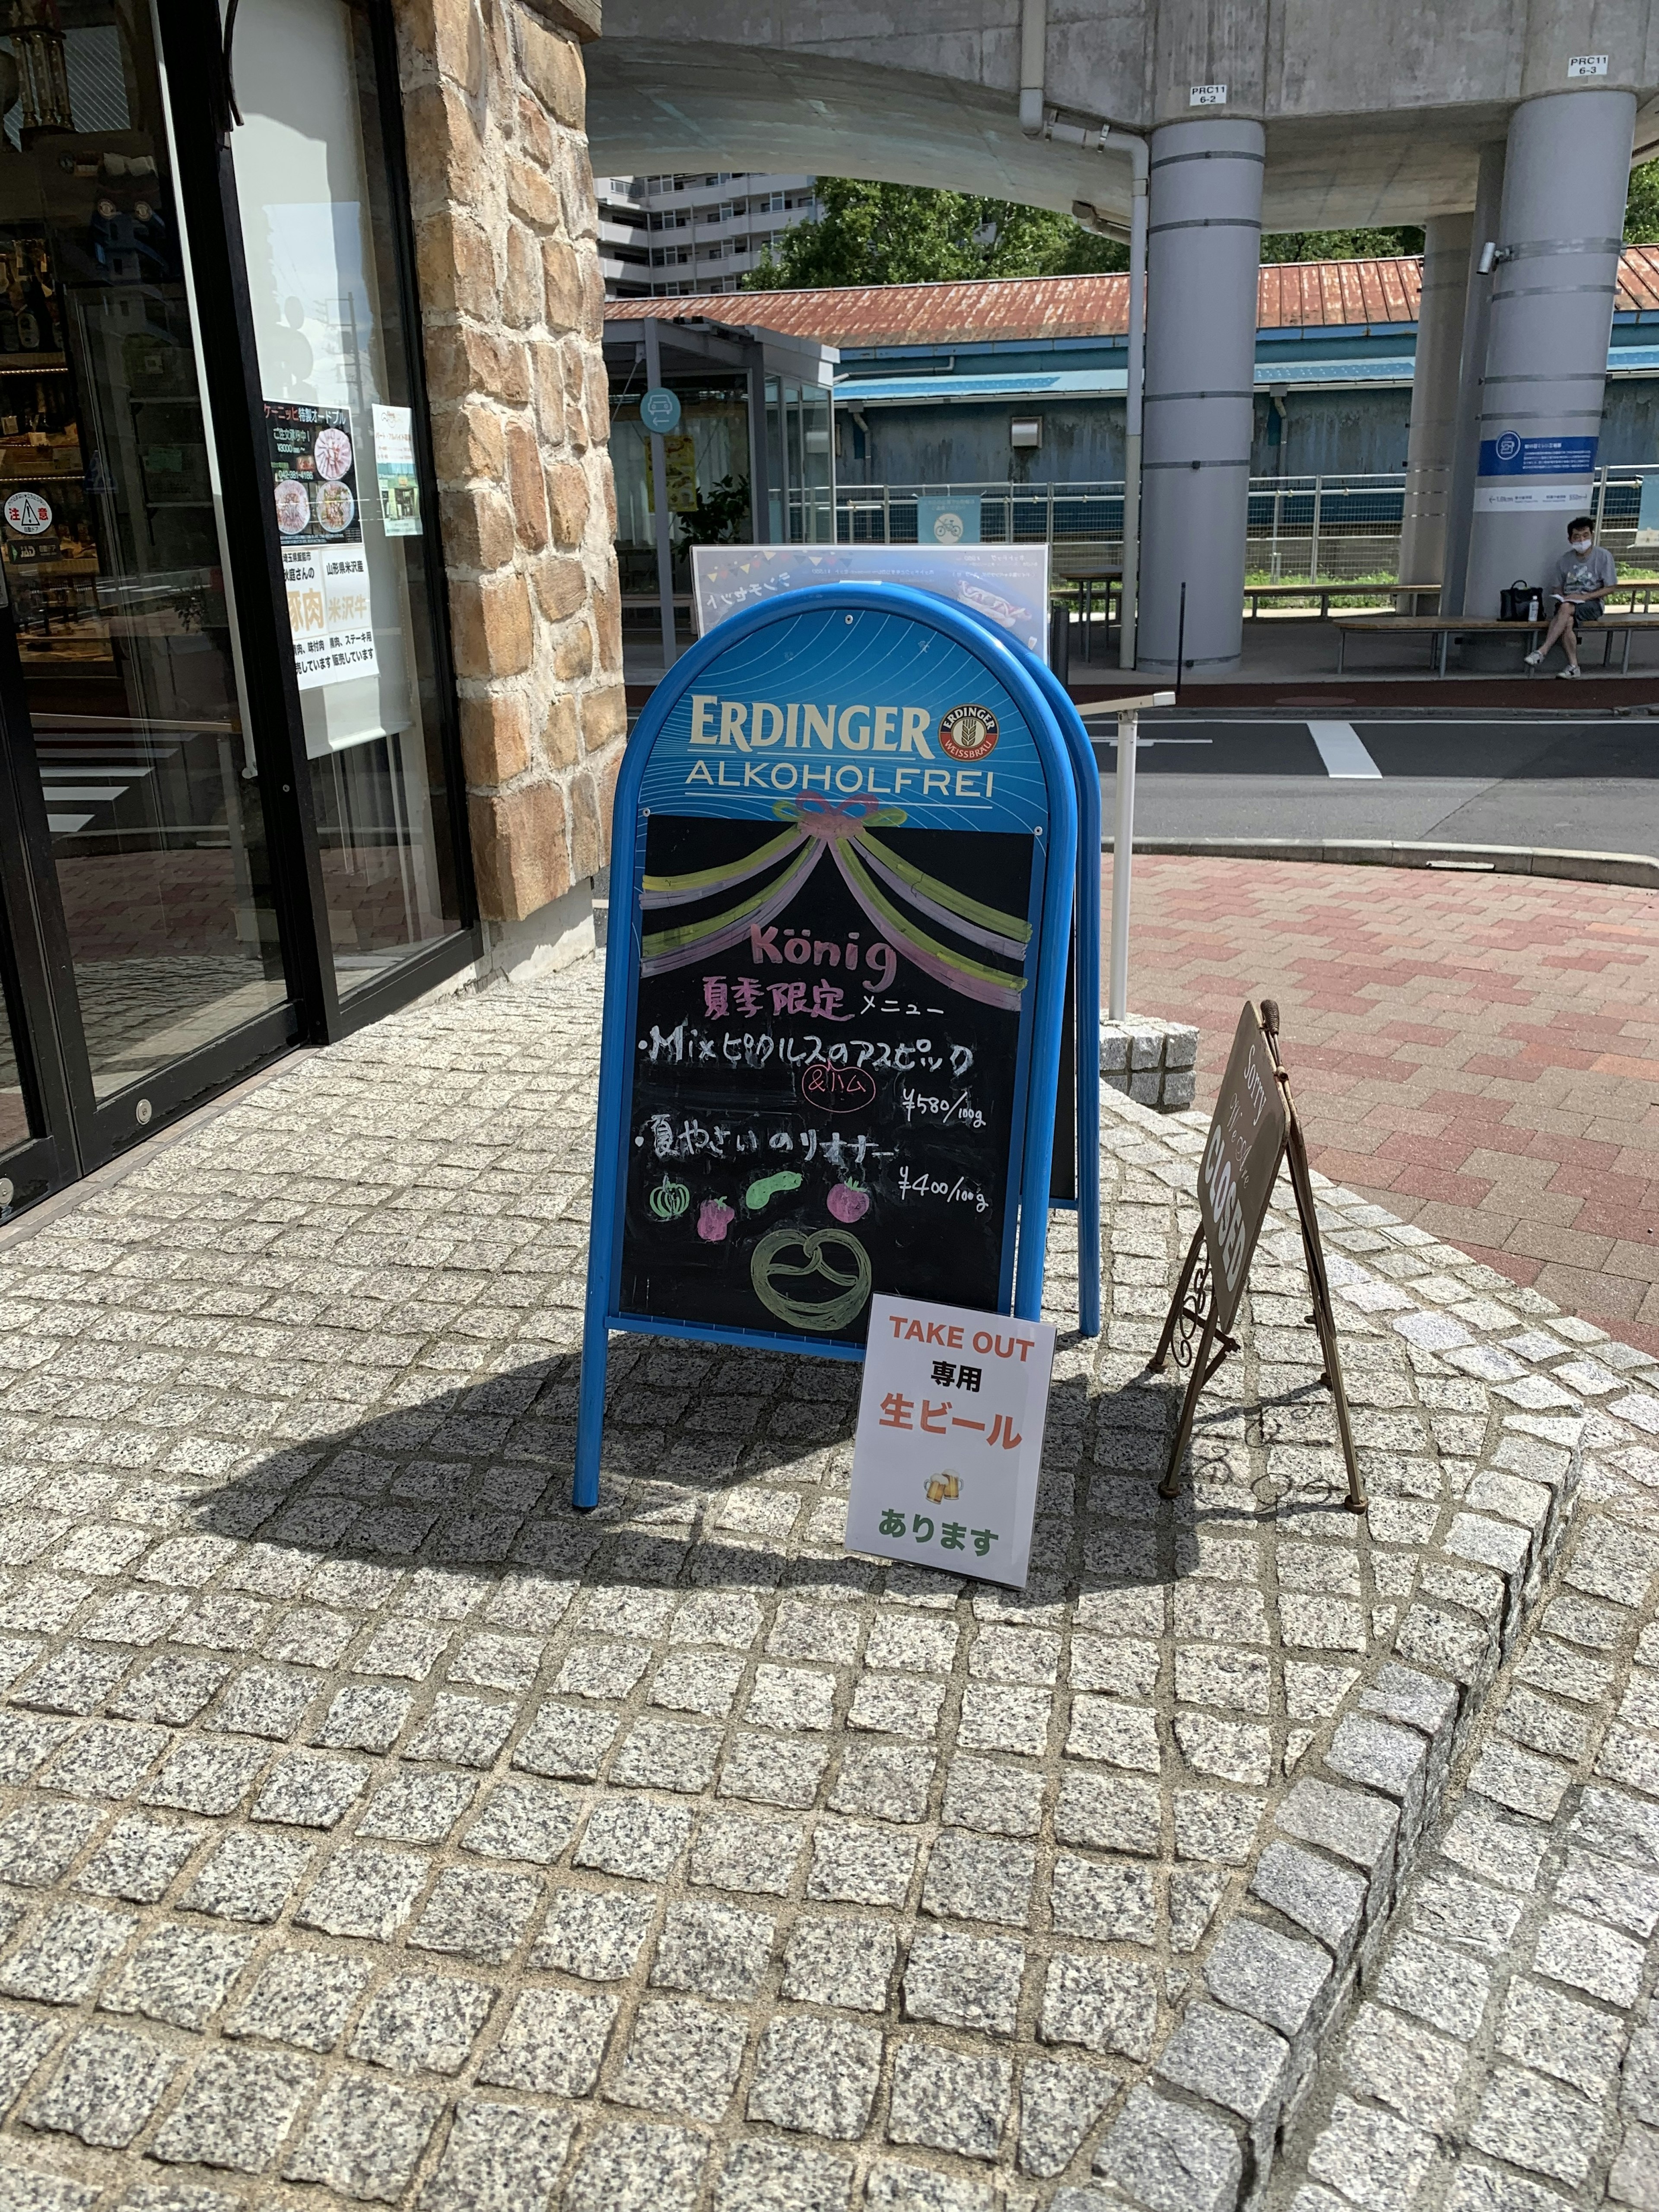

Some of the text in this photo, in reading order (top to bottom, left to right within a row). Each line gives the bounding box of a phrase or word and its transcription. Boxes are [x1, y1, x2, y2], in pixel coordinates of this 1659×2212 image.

[1571, 57, 1606, 66] PRC11
[1192, 86, 1224, 95] PRC11
[9, 508, 48, 520] 注 意
[283, 552, 311, 563] 埼玉県飯能市
[326, 560, 364, 575] 山形県米沢産
[328, 594, 367, 623] 米沢牛
[332, 648, 373, 666] 販売しています
[689, 695, 936, 760] ERDINGER
[943, 707, 995, 730] ERDINGER
[685, 760, 994, 798] ALKOHOLFREI
[750, 923, 897, 993] König
[702, 975, 944, 1020] 夏季限定 メニュー
[808, 1069, 866, 1092] &ハム
[1243, 1044, 1267, 1126] Sorry
[903, 1088, 986, 1128] ¥580/100g
[899, 1166, 989, 1213] ¥400/100g
[1205, 1125, 1246, 1292] CLOSED
[889, 1316, 1035, 1362] TAKE OUT
[931, 1360, 982, 1392] 専用
[879, 1392, 1023, 1450] 生ビール
[878, 1508, 999, 1556] あります
